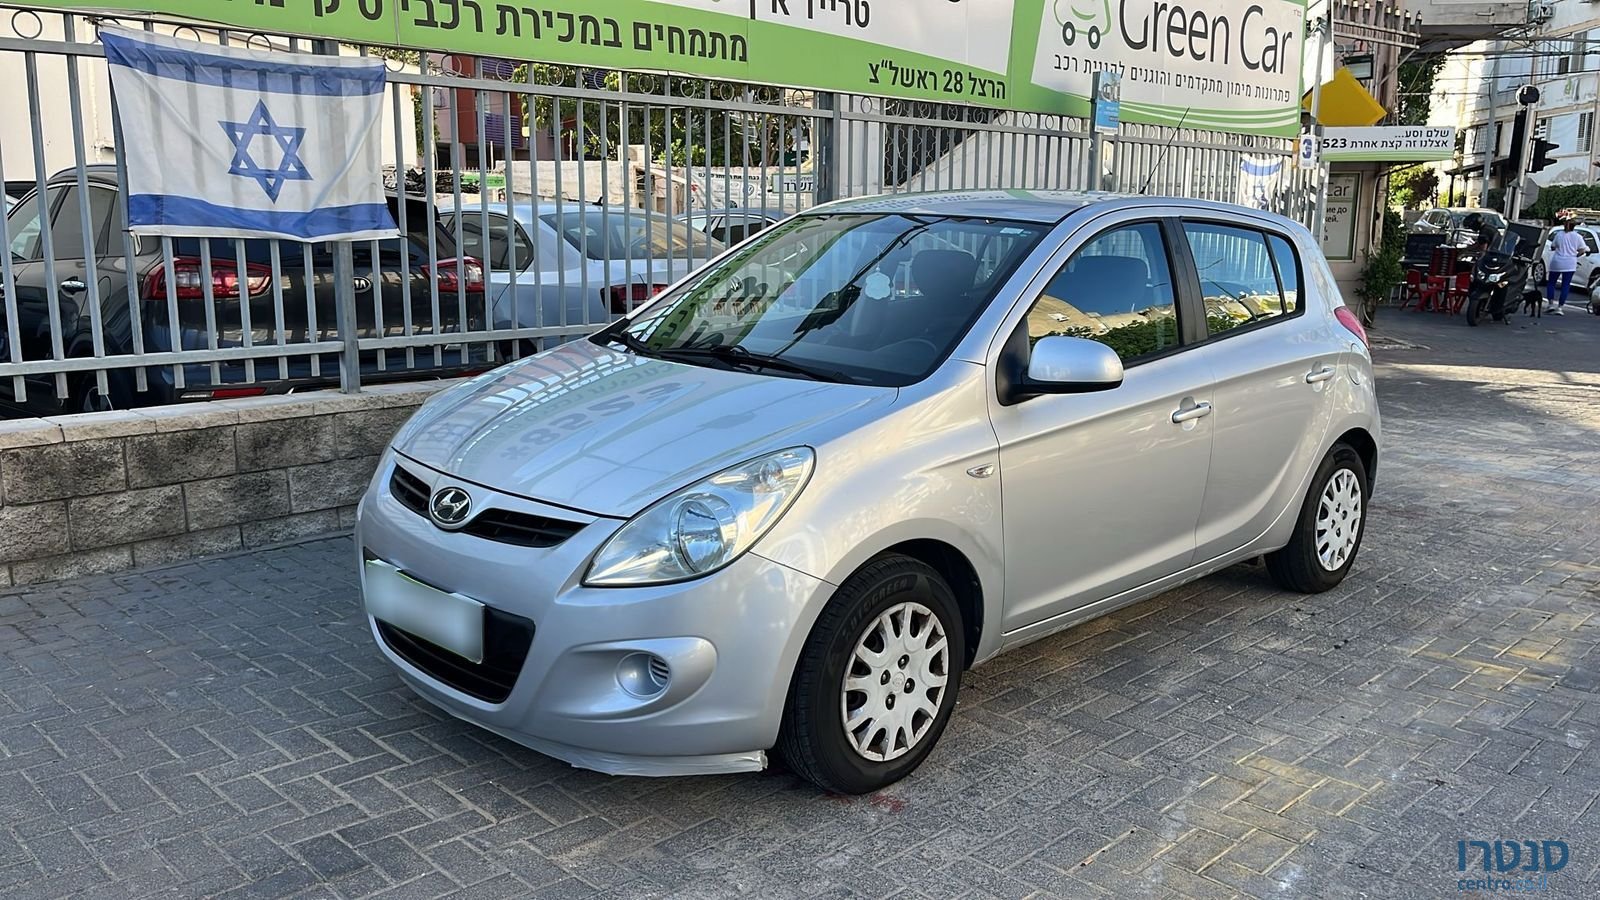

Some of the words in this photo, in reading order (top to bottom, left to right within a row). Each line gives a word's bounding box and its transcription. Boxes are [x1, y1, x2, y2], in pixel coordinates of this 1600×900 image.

[400, 0, 483, 33] רכבי
[495, 4, 623, 48] במכירת
[632, 21, 748, 62] מתמחים
[1119, 0, 1230, 65] Green
[1239, 4, 1293, 75] Car
[1053, 54, 1079, 72] רכב
[868, 59, 938, 91] ראשל"צ
[943, 69, 963, 94] 28
[1130, 66, 1171, 86] והוגנים
[1175, 73, 1223, 95] מתקדמים
[968, 72, 1006, 99] הרצל
[1226, 81, 1252, 98] מימון
[1254, 85, 1290, 102] פתרונות
[1394, 130, 1423, 138] וסע...
[1420, 138, 1449, 148] אצלנו
[1426, 129, 1450, 138] שלם
[1350, 139, 1378, 149] אחרת
[1380, 139, 1402, 151] קצת
[1405, 139, 1417, 148] זה
